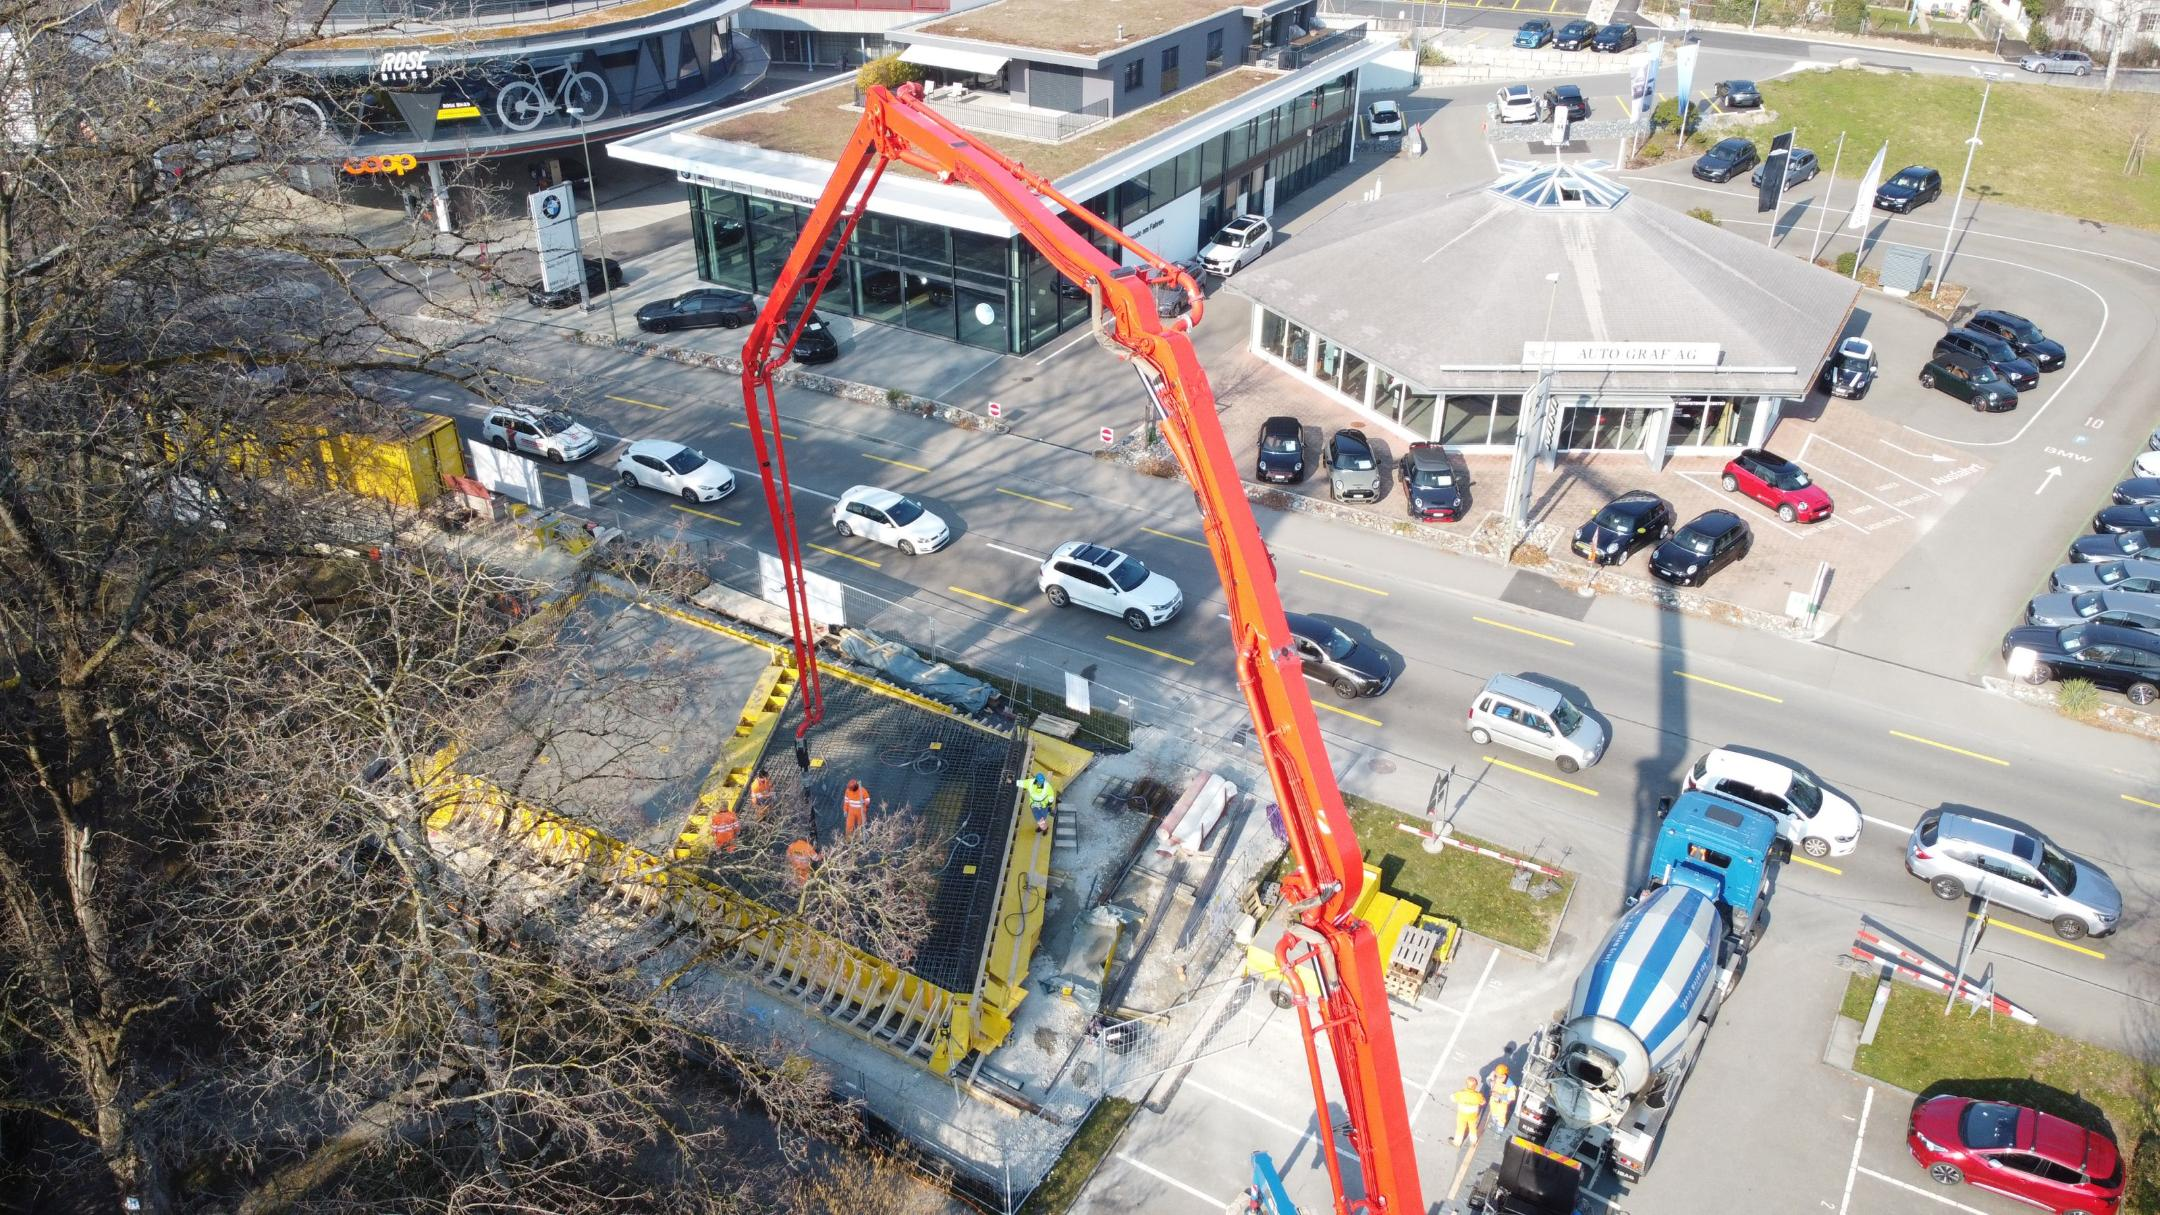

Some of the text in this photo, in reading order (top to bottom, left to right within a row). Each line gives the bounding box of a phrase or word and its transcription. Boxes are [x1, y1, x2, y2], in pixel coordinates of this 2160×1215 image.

[380, 51, 430, 71] ROSE
[380, 71, 429, 81] BIKES
[343, 153, 418, 176] coop
[1676, 348, 1698, 360] AG
[2084, 416, 2105, 429] 10
[2043, 446, 2094, 463] BMW
[1929, 463, 1985, 486] Ausfahrt
